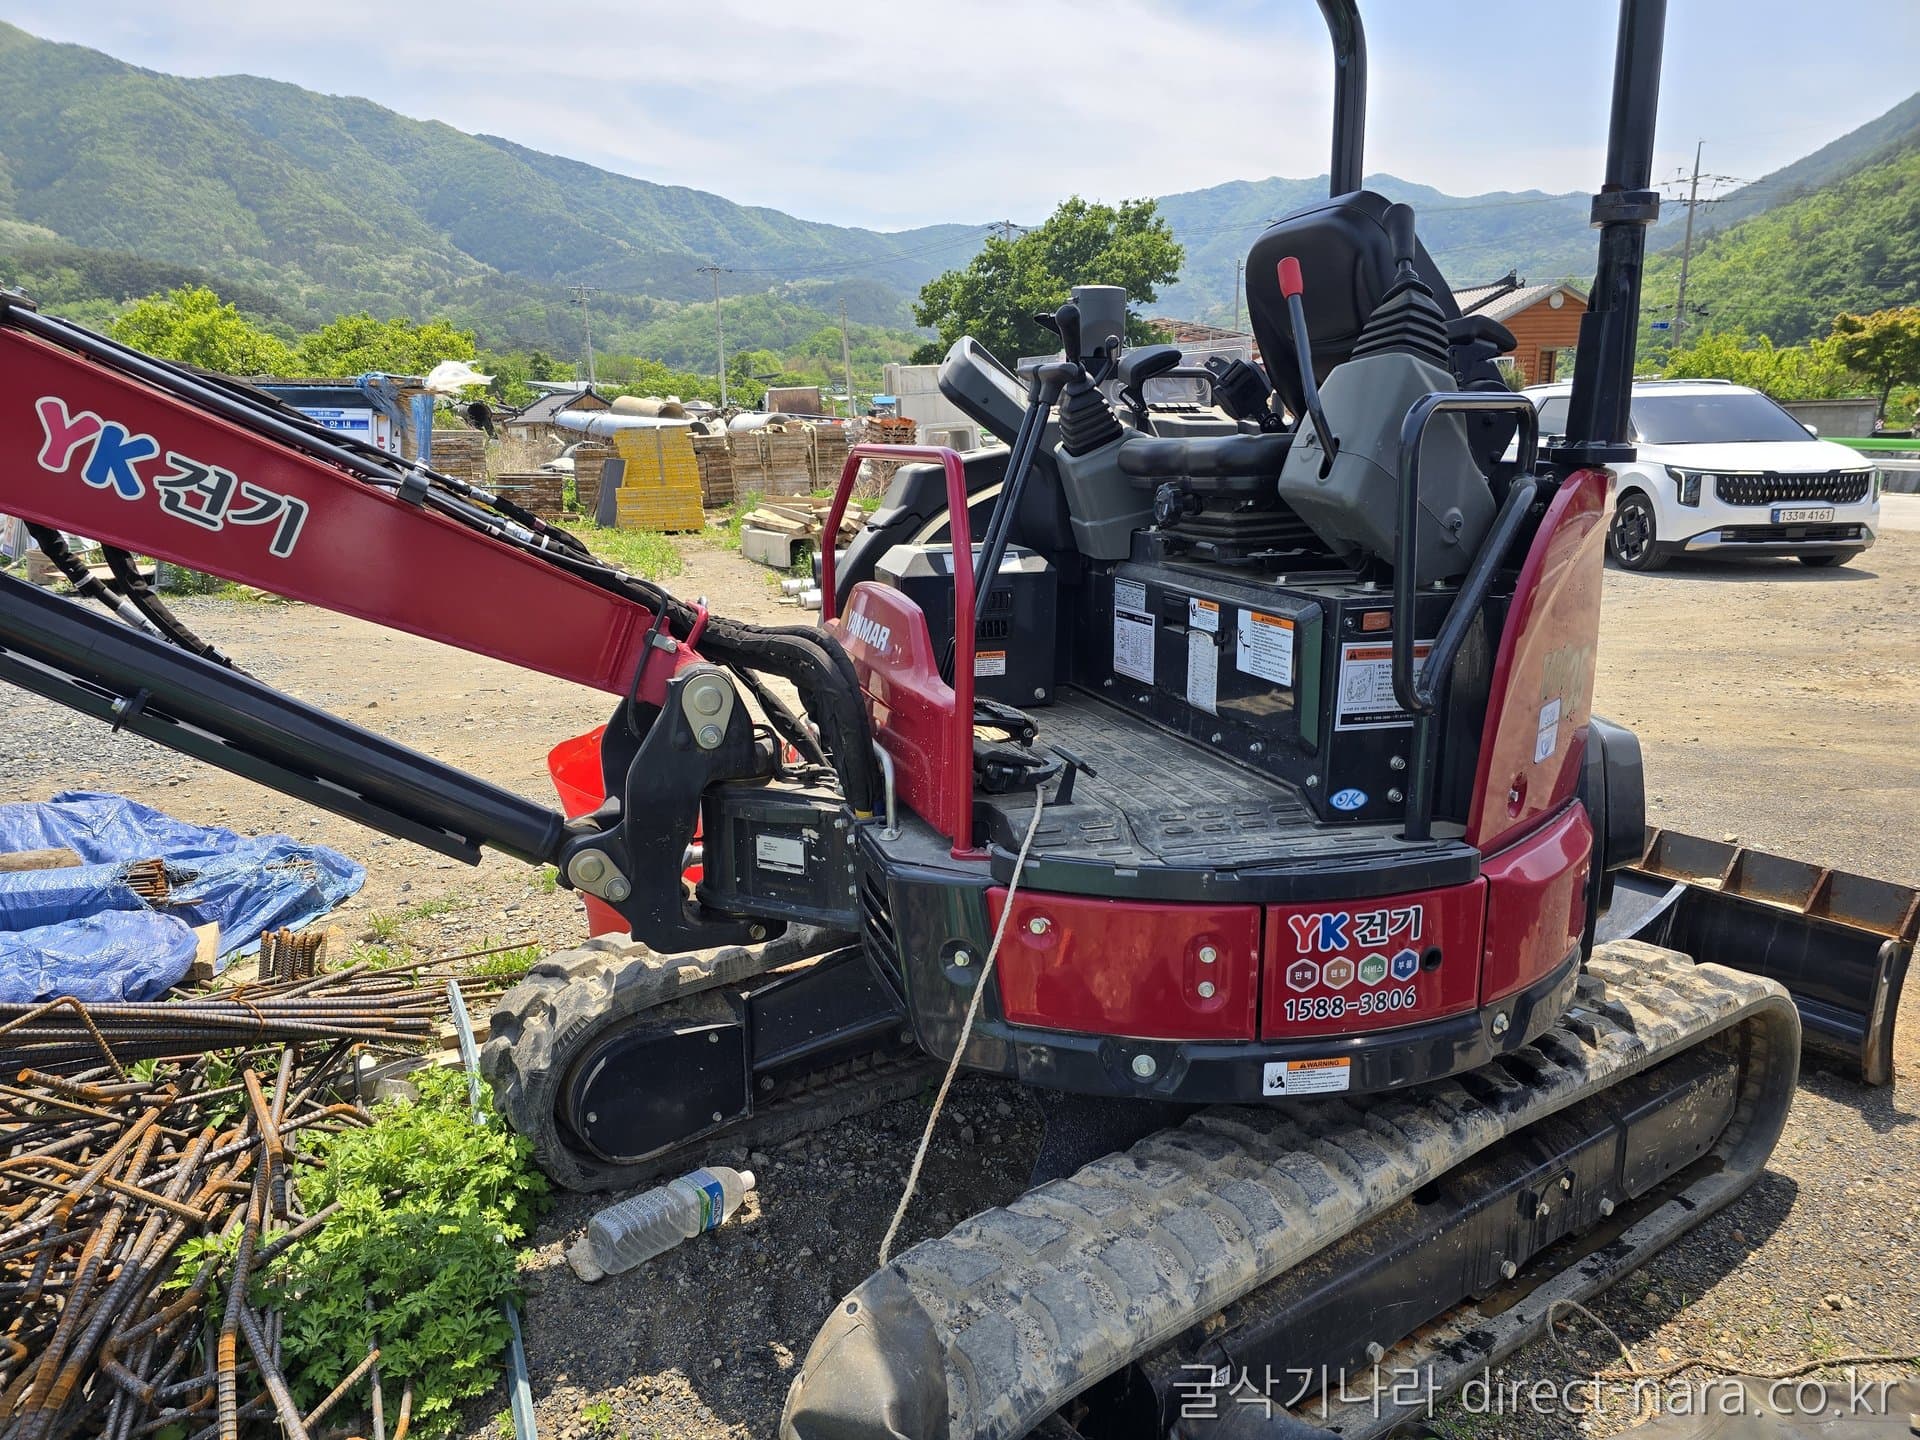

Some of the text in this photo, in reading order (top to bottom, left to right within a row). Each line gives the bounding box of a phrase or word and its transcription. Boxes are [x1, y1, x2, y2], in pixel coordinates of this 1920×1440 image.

[1808, 510, 1831, 520] 4161
[1336, 792, 1361, 806] OK
[1362, 964, 1384, 975] 서비스
[1284, 985, 1416, 1020] 1588-3806
[1307, 1059, 1340, 1068] WARNING
